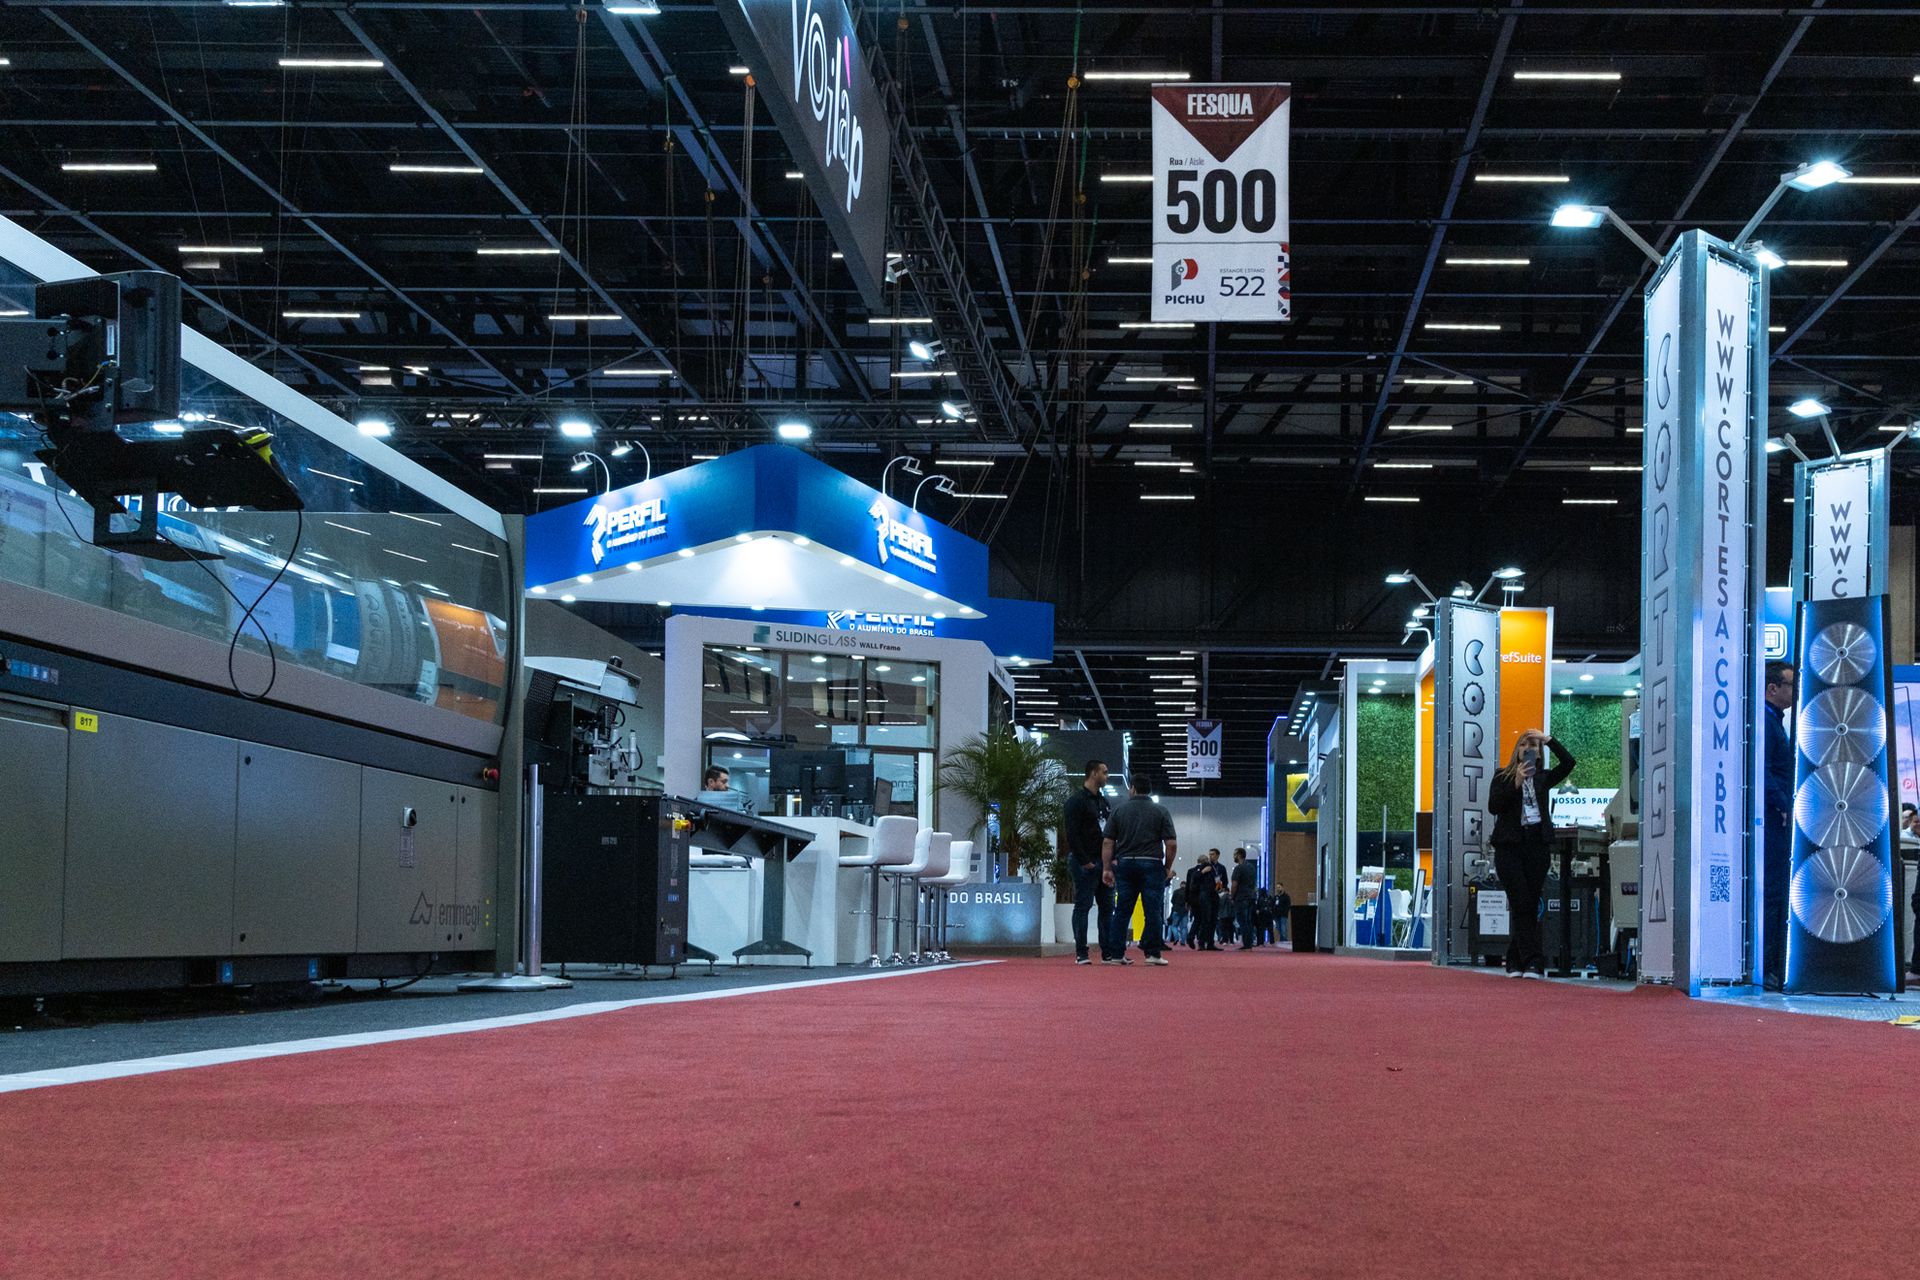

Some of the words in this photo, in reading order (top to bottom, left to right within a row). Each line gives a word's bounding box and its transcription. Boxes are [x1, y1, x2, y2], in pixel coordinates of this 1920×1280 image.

[1187, 93, 1254, 118] FESQUA
[1169, 158, 1183, 166] Rua
[1166, 169, 1276, 234] 500
[1219, 276, 1266, 297] 522
[1165, 295, 1205, 305] PICHU
[607, 498, 668, 535] PERFIL
[849, 623, 855, 631] O
[857, 624, 894, 634] ALUMÍNIO
[909, 628, 935, 637] BRASIL
[859, 641, 879, 650] WALL
[1500, 651, 1542, 664] efSuite
[80, 716, 93, 727] 817
[1191, 740, 1218, 757] 500
[950, 891, 969, 904] DO
[975, 891, 1024, 905] BRASIL
[439, 903, 480, 933] emmegi
